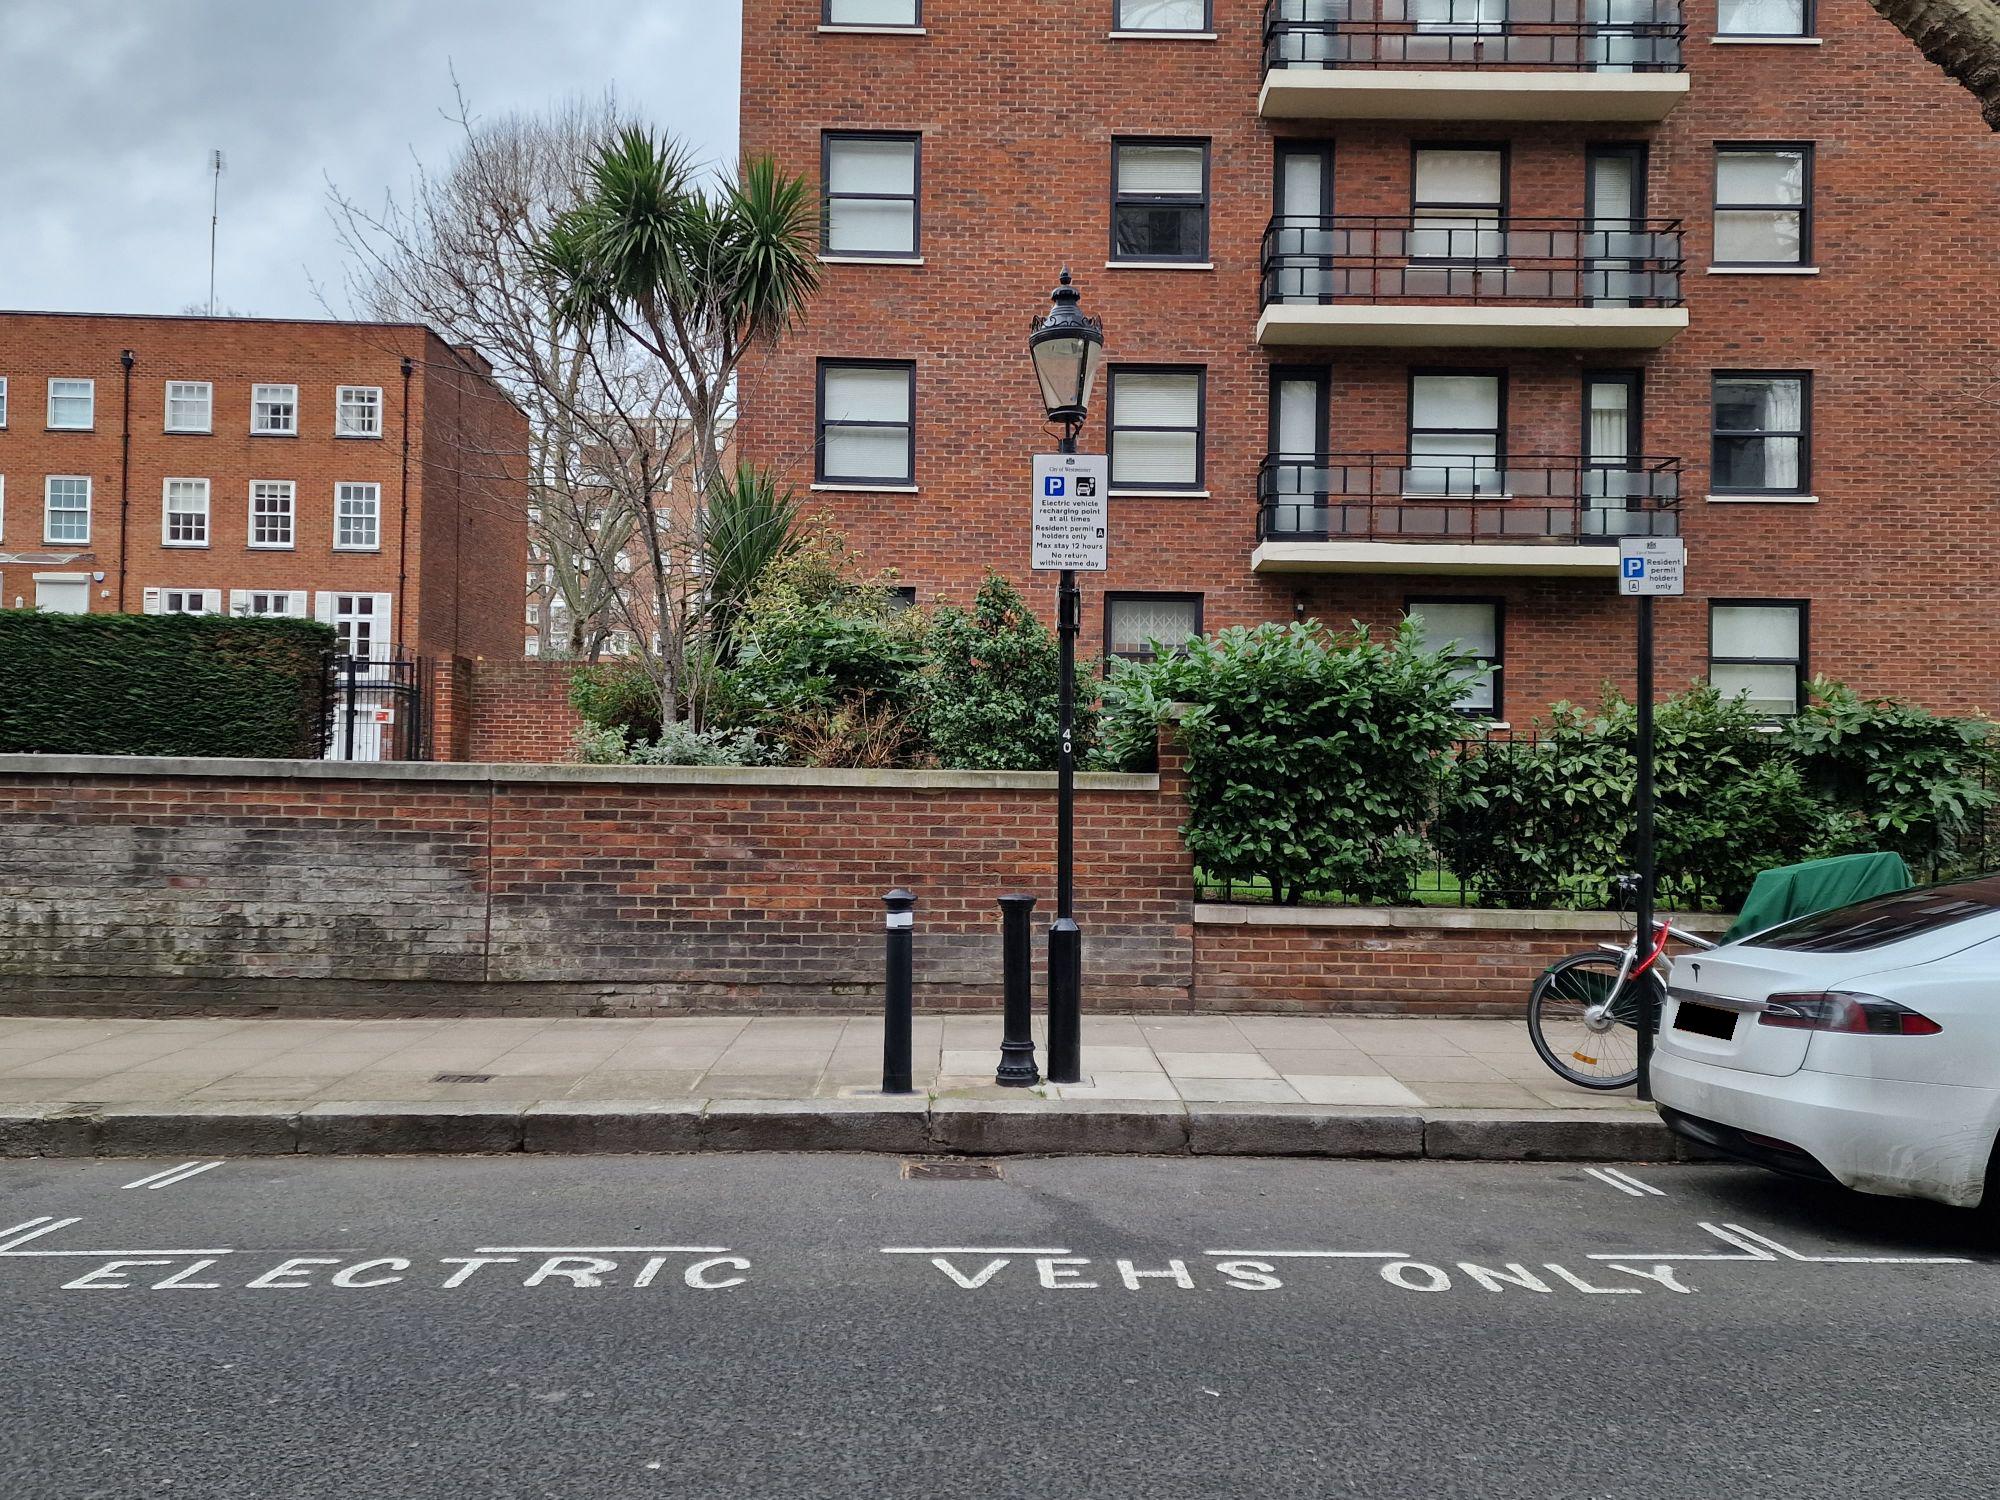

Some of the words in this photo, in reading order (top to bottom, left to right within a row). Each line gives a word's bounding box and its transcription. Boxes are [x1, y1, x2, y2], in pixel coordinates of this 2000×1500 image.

[1049, 478, 1062, 494] P
[1072, 533, 1087, 541] only
[1086, 560, 1099, 568] day
[1628, 560, 1641, 576] P
[60, 1256, 752, 1290] ELECTRIC
[930, 1257, 1284, 1291] VEHS
[1379, 1260, 1700, 1294] ONLY
